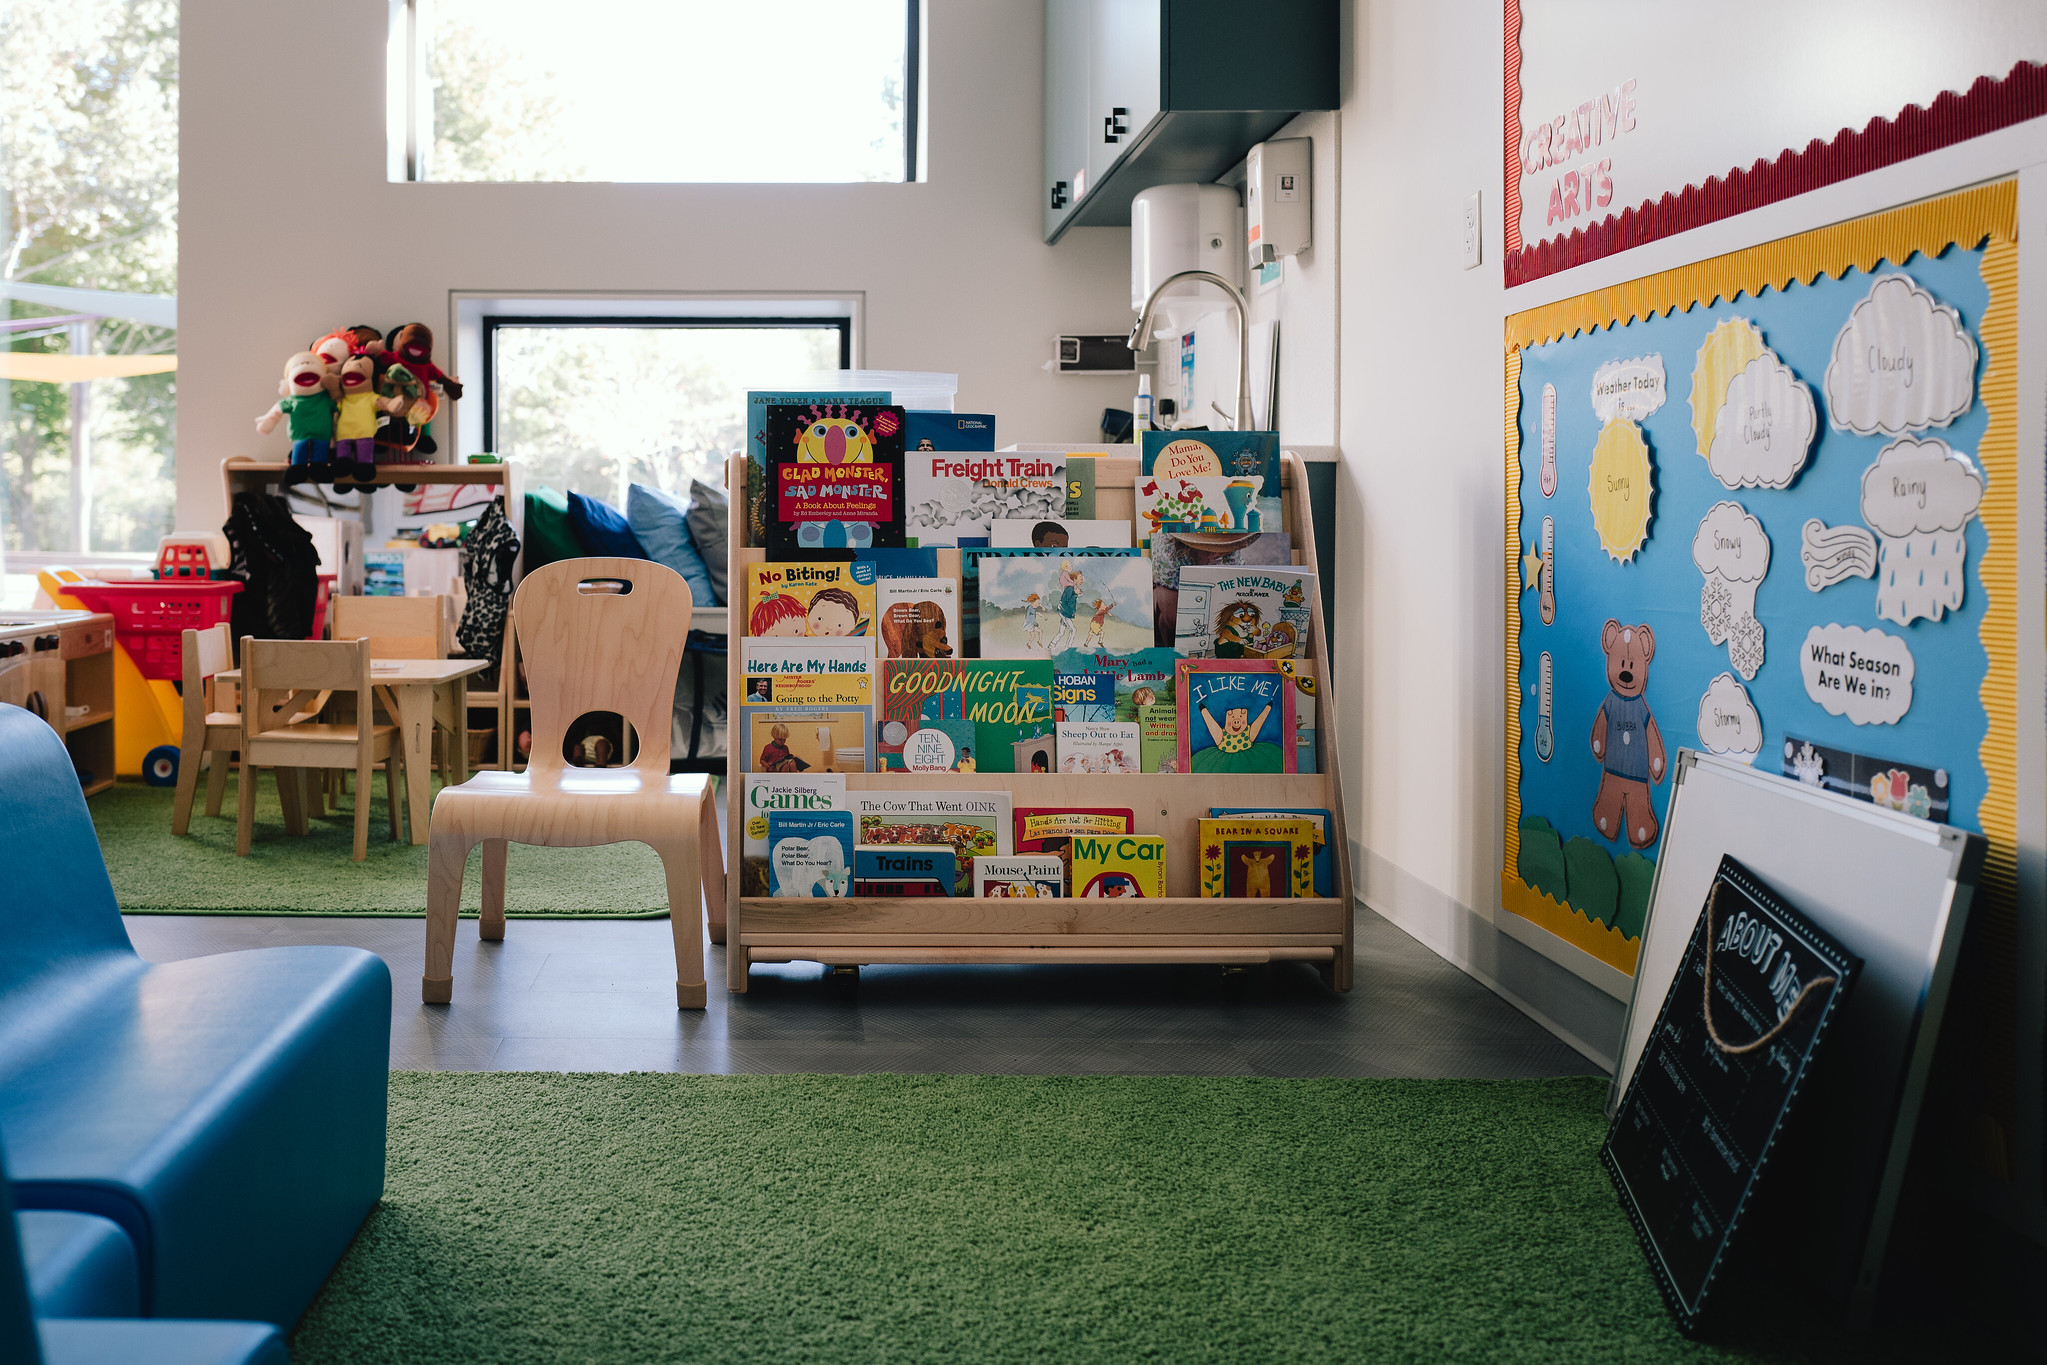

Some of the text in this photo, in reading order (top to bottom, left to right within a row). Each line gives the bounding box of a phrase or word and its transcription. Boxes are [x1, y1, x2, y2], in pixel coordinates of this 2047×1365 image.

[1523, 78, 1636, 174] CREATIVE
[1547, 158, 1612, 226] ARTS
[1869, 346, 1913, 388] Cloudy
[1597, 374, 1660, 396] Weather Today
[1750, 406, 1772, 426] Partly
[1744, 426, 1770, 451] Cloudy
[1169, 443, 1202, 456] Mama,
[932, 459, 1052, 481] Freight Train
[1171, 454, 1204, 468] Do You
[782, 465, 888, 483] GLAD MONSTER,
[1168, 462, 1211, 479] Love Me?
[785, 484, 887, 500] SAD MONSTER
[983, 478, 1053, 488] Donald Crews
[1607, 474, 1630, 501] Sunny
[1893, 477, 1926, 509] Rainy
[1714, 530, 1741, 559] Snowy
[759, 567, 840, 585] No Biting!
[1217, 576, 1290, 593] THE NEW BABY
[748, 660, 866, 674] Here Are My Hands
[1094, 654, 1129, 669] Mary
[1812, 645, 1900, 676] What Season
[890, 671, 1025, 694] GOODNIGHT
[1058, 676, 1096, 685] HOBAN
[1128, 670, 1165, 682] Lamb
[1818, 670, 1891, 700] Are We in?
[1054, 685, 1096, 704] Signs
[1192, 676, 1280, 704] I LIKE ME!
[776, 694, 804, 705] Going
[819, 694, 833, 703] the
[836, 694, 859, 704] Potty
[969, 702, 1040, 725] MOON
[1714, 708, 1741, 734] Stormy
[1062, 731, 1087, 740] Sheep
[914, 755, 946, 764] EIGHT
[751, 785, 832, 809] Games
[795, 787, 817, 795] Silberg
[761, 810, 768, 818] to
[861, 801, 996, 812] The Cow That Went OINK
[1030, 817, 1052, 827] Hands
[1094, 817, 1121, 829] Hitting
[1074, 839, 1164, 864] My Car
[876, 856, 933, 871] Trains
[984, 864, 1061, 875] Mouse Paint
[1715, 911, 1784, 974] ABOUT
[1769, 951, 1800, 1023] ME
